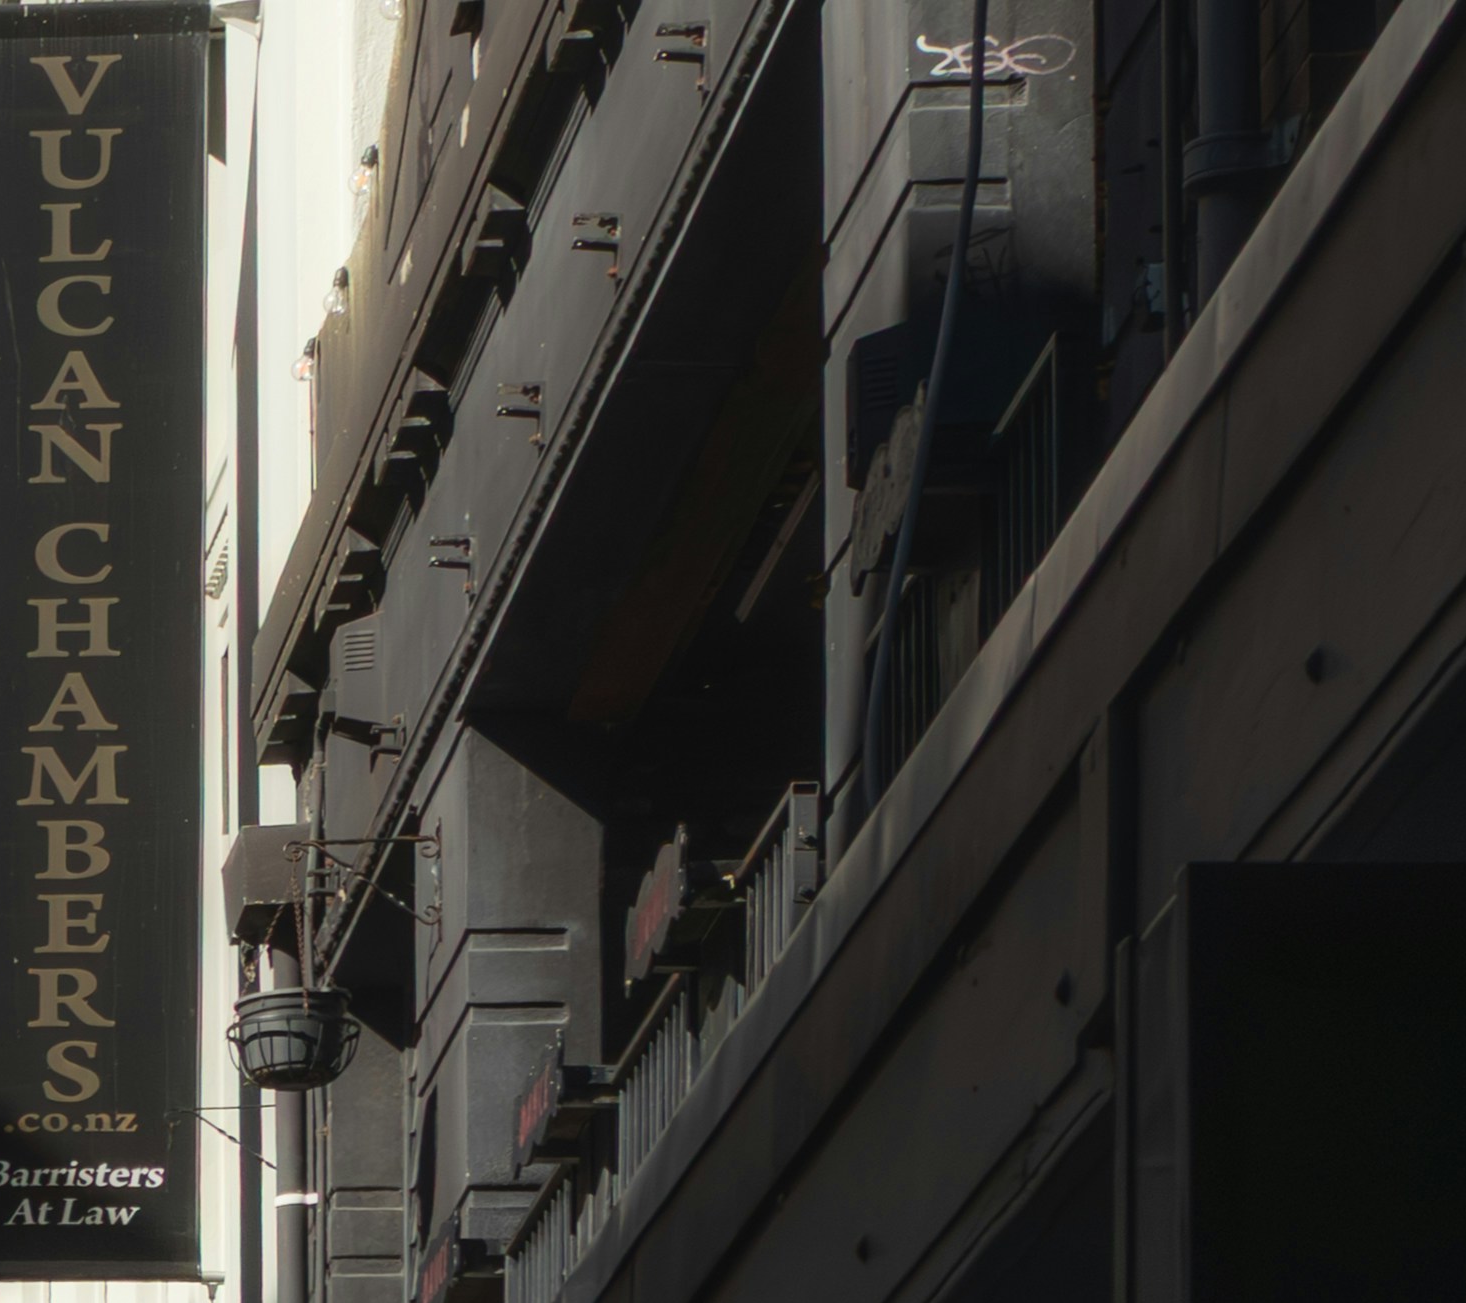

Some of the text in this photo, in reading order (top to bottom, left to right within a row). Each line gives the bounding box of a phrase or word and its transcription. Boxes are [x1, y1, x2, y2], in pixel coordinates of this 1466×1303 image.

[15, 53, 130, 1104] VULCAN CHAMBERS
[3, 1111, 140, 1134] .co.nz
[2, 1197, 142, 1226] At Law
